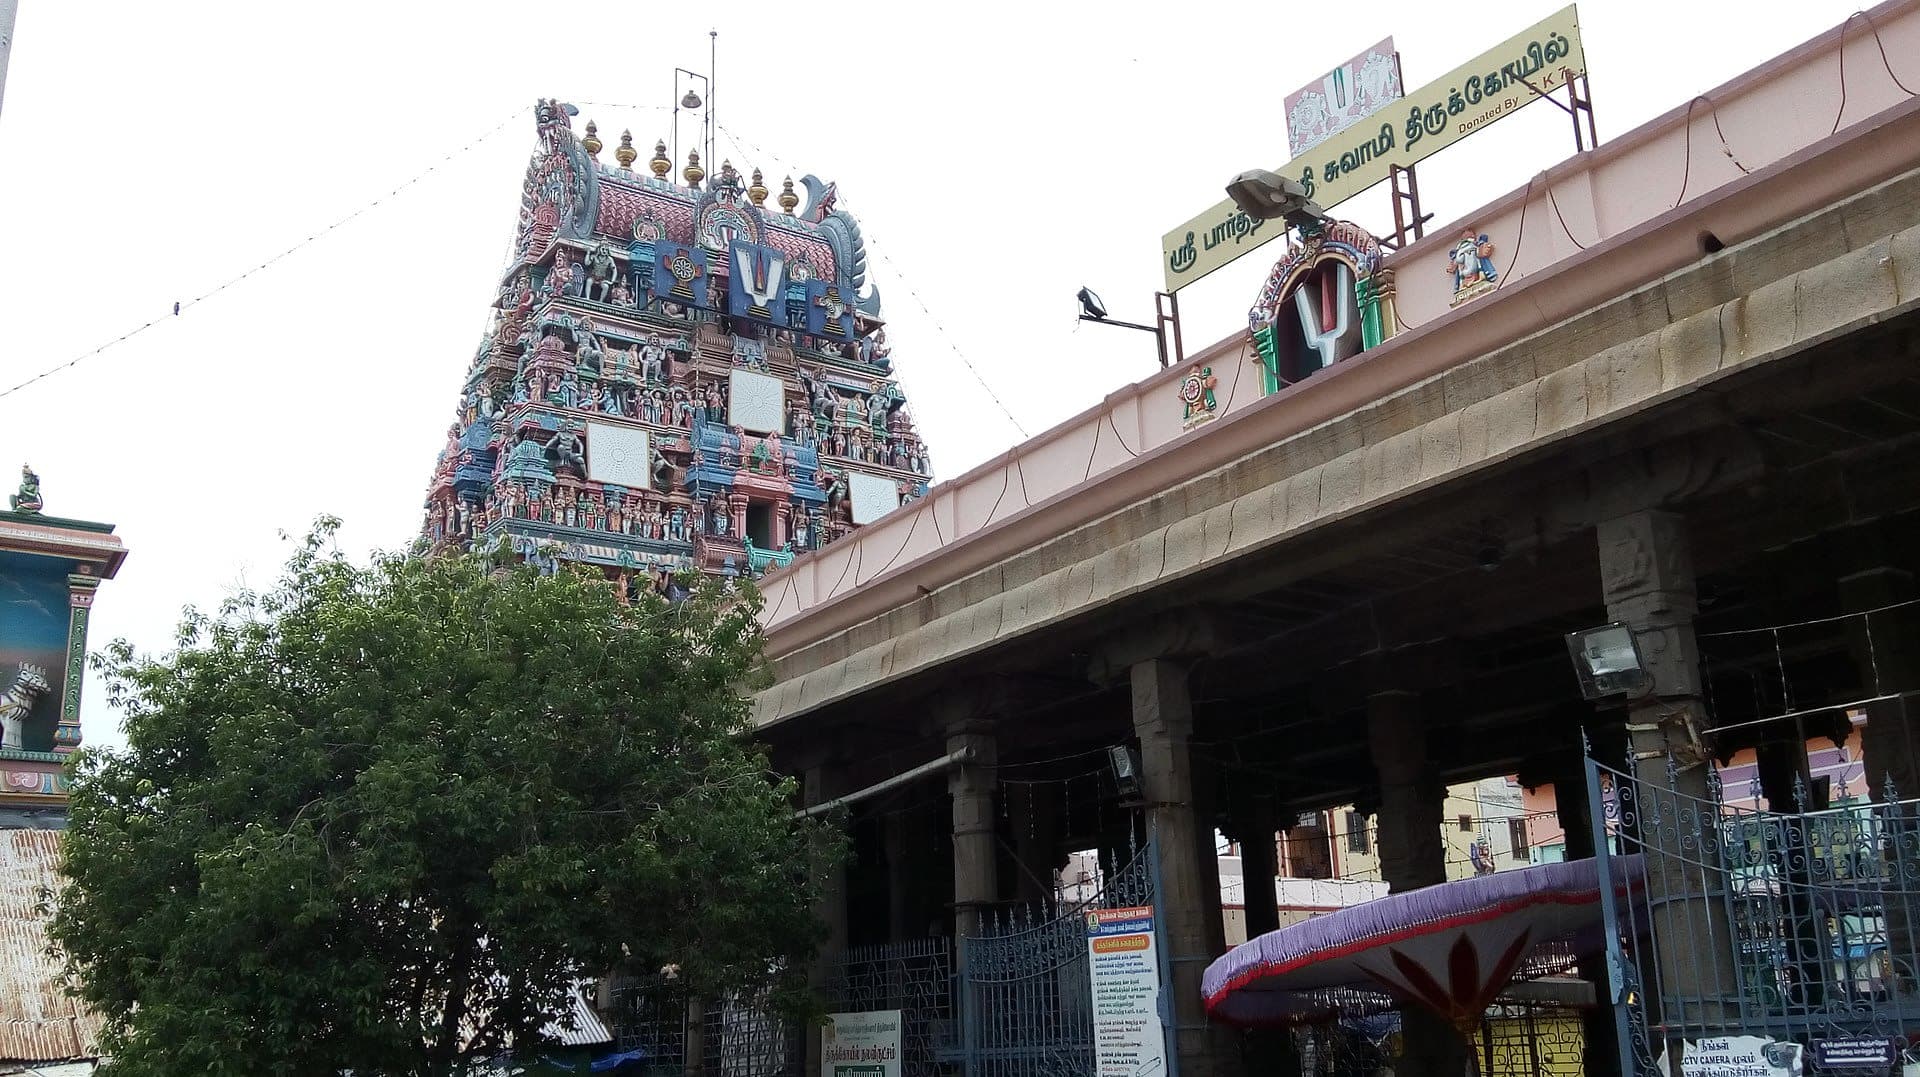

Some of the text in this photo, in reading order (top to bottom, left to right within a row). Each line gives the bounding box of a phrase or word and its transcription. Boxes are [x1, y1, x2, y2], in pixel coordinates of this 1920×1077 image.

[1458, 104, 1502, 133] Donated
[1504, 96, 1519, 112] By
[1170, 231, 1197, 273] ஸ்ரீ
[1323, 123, 1396, 184] சுவாமி
[1404, 31, 1570, 151] திருக்கோயில்
[1682, 1055, 1698, 1065] CTV
[1700, 1055, 1731, 1065] CAMERA
